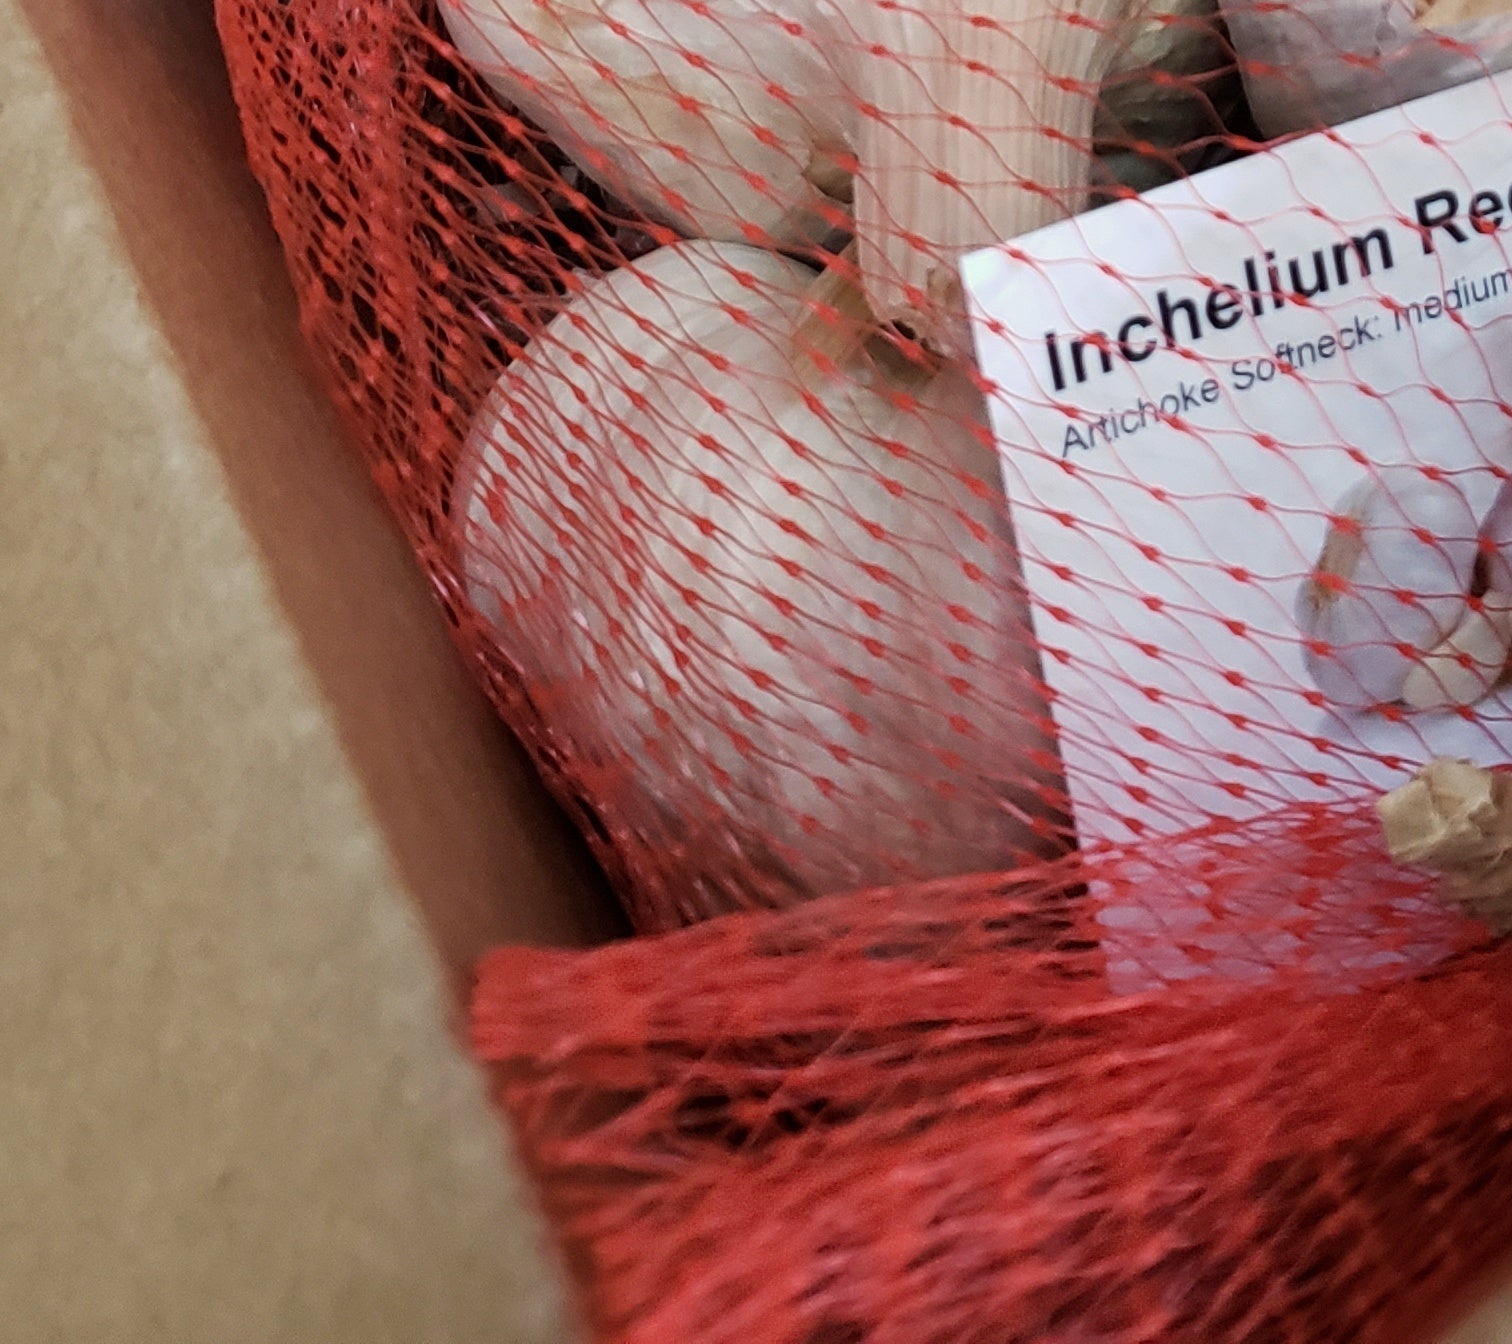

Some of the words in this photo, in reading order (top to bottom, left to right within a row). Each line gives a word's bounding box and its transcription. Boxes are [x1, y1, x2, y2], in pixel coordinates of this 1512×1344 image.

[1045, 227, 1394, 391] Inchelium
[1062, 377, 1219, 457] Artichoke
[1231, 313, 1383, 390] Softneck:
